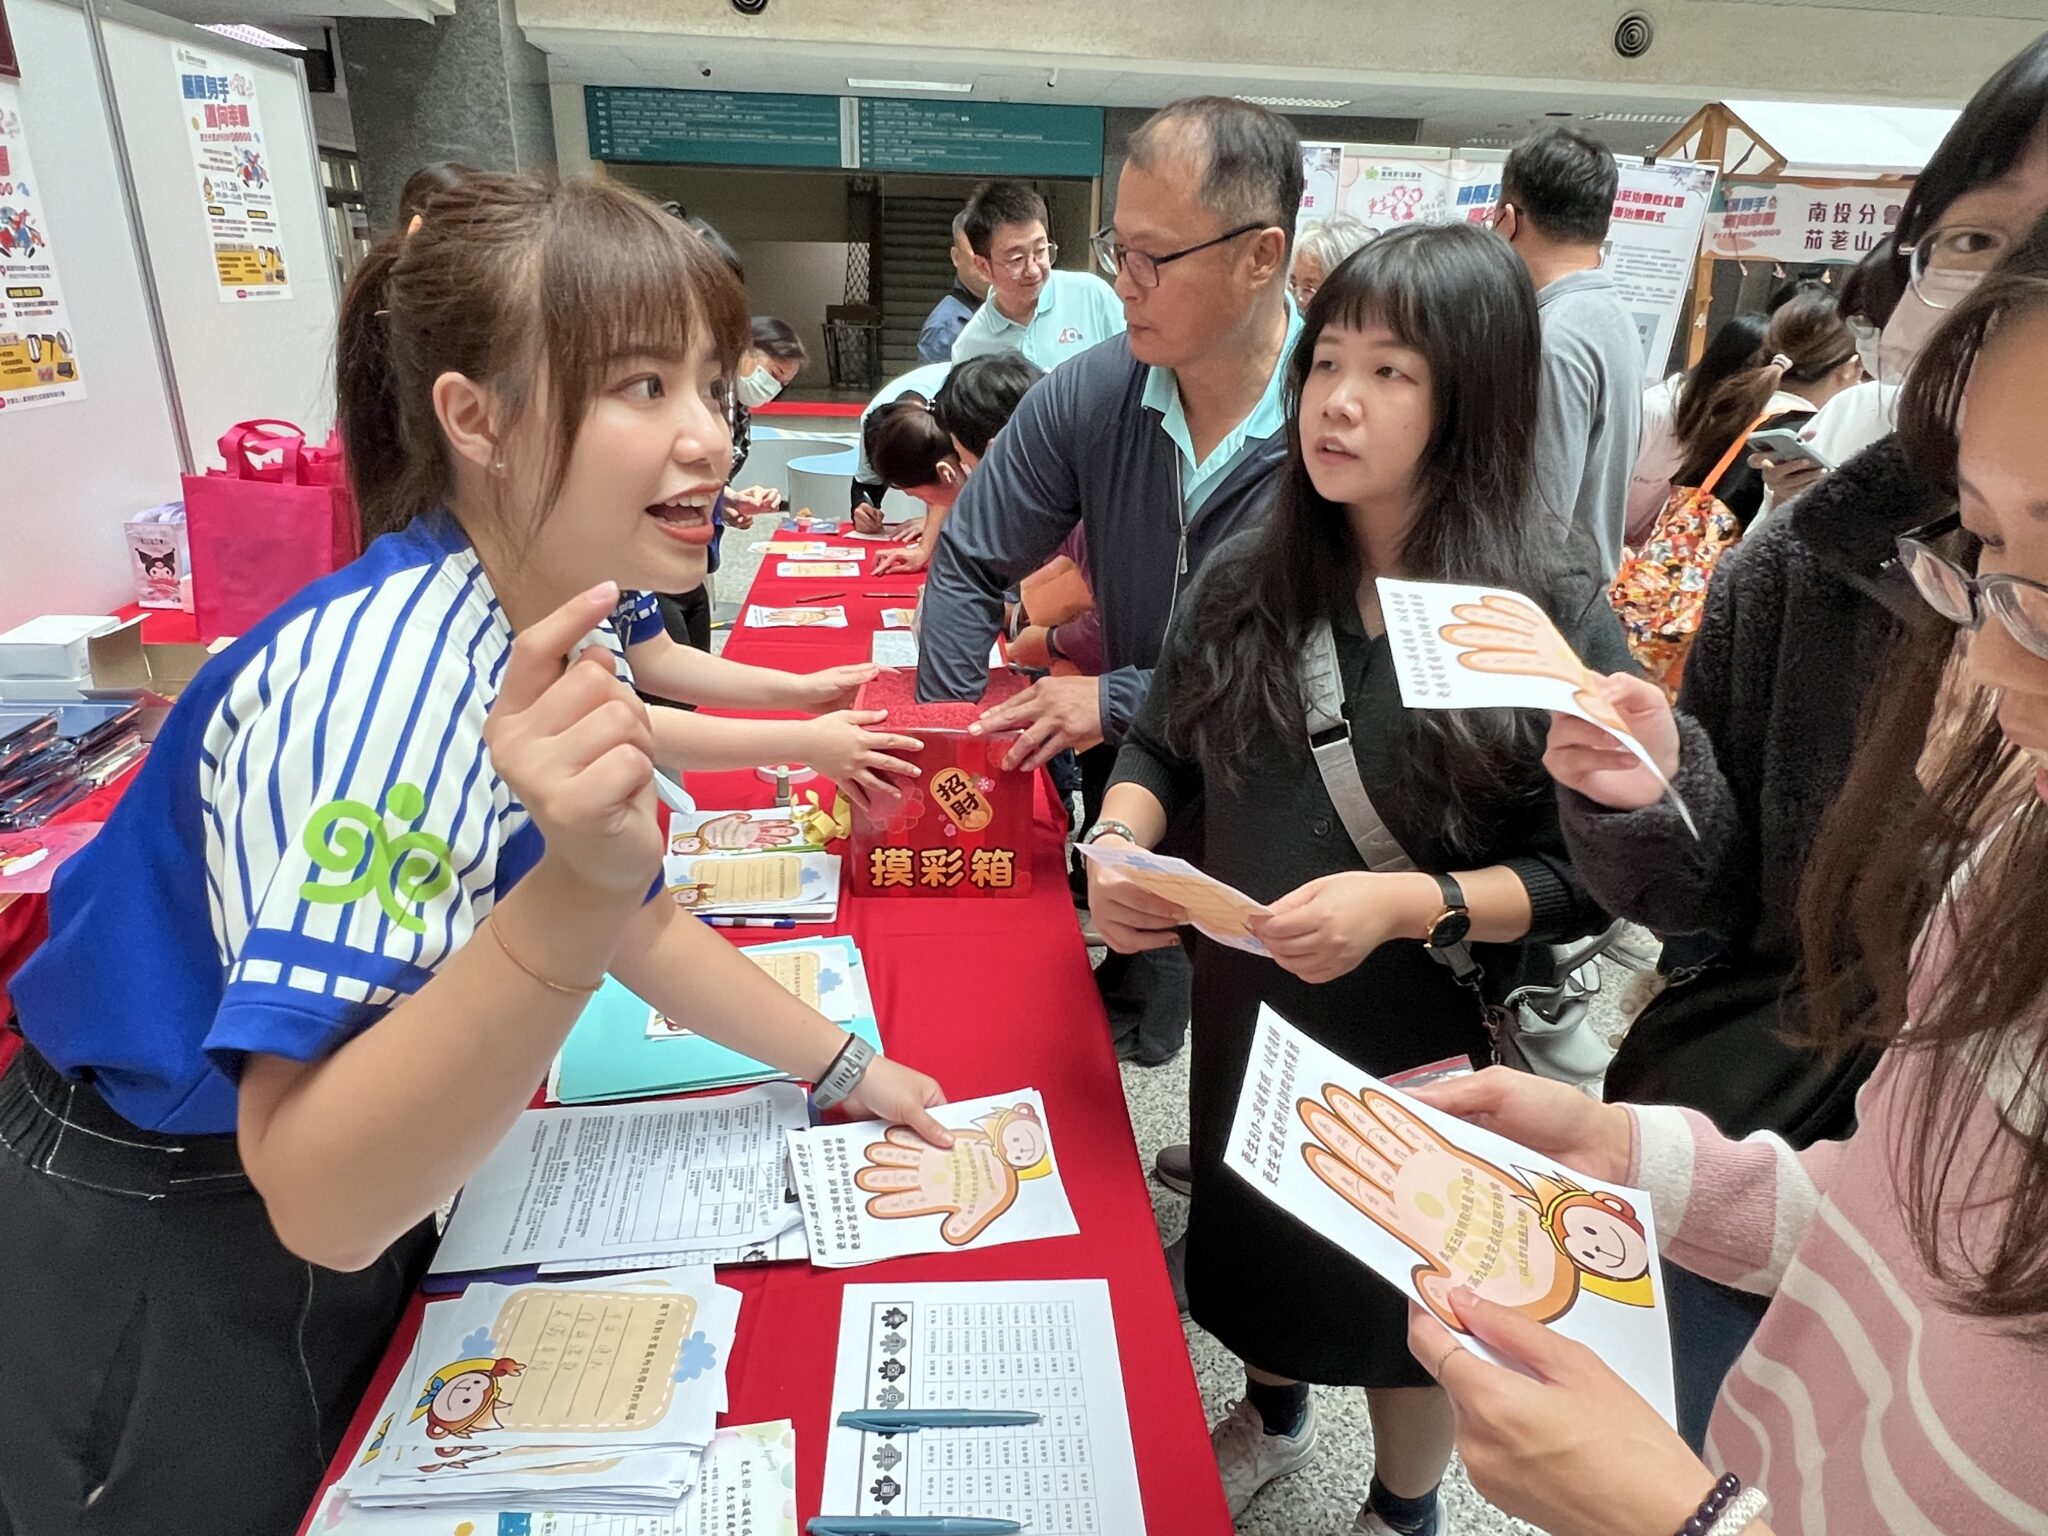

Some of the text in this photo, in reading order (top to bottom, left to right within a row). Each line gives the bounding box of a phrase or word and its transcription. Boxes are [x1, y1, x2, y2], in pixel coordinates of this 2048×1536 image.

[1808, 202, 1902, 225] 南投分會
[1804, 229, 1896, 251] 茄荖山
[936, 773, 980, 821] 招財
[870, 847, 1016, 888] 摸彩箱
